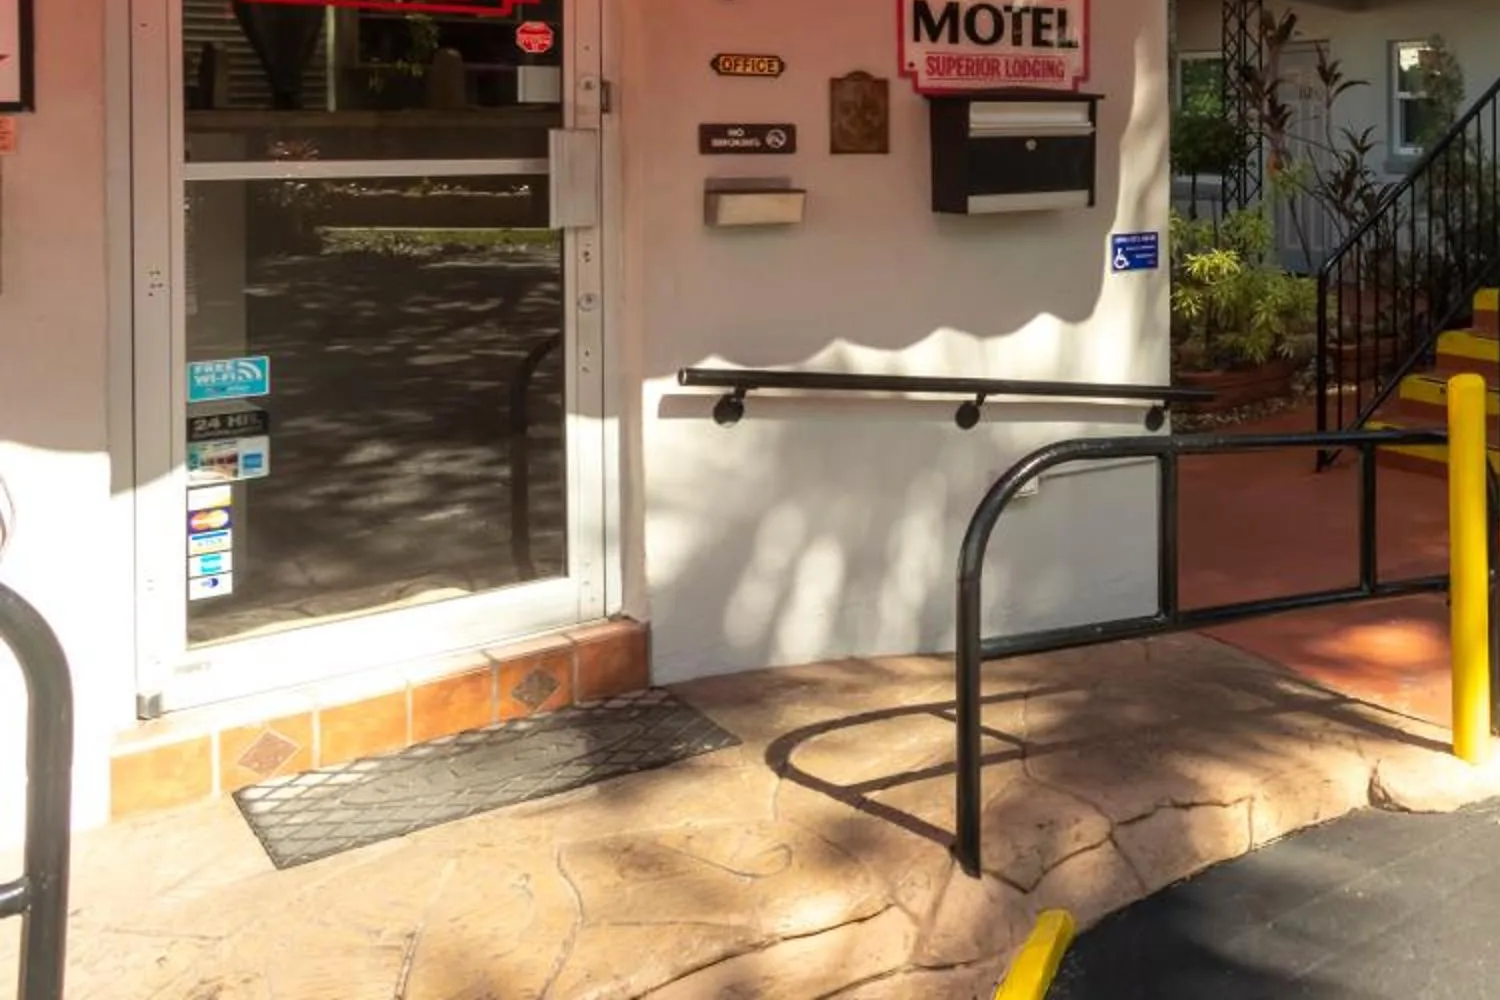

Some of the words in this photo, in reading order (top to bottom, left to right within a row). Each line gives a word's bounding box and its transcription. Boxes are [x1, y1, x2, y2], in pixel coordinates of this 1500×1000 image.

[912, 0, 1079, 49] MOTEL
[721, 57, 776, 74] OFFICE
[925, 55, 1001, 77] SUPERIOR
[1005, 58, 1065, 79] LODGING
[727, 127, 745, 137] NO
[194, 362, 234, 373] FREE
[194, 417, 220, 431] 24
